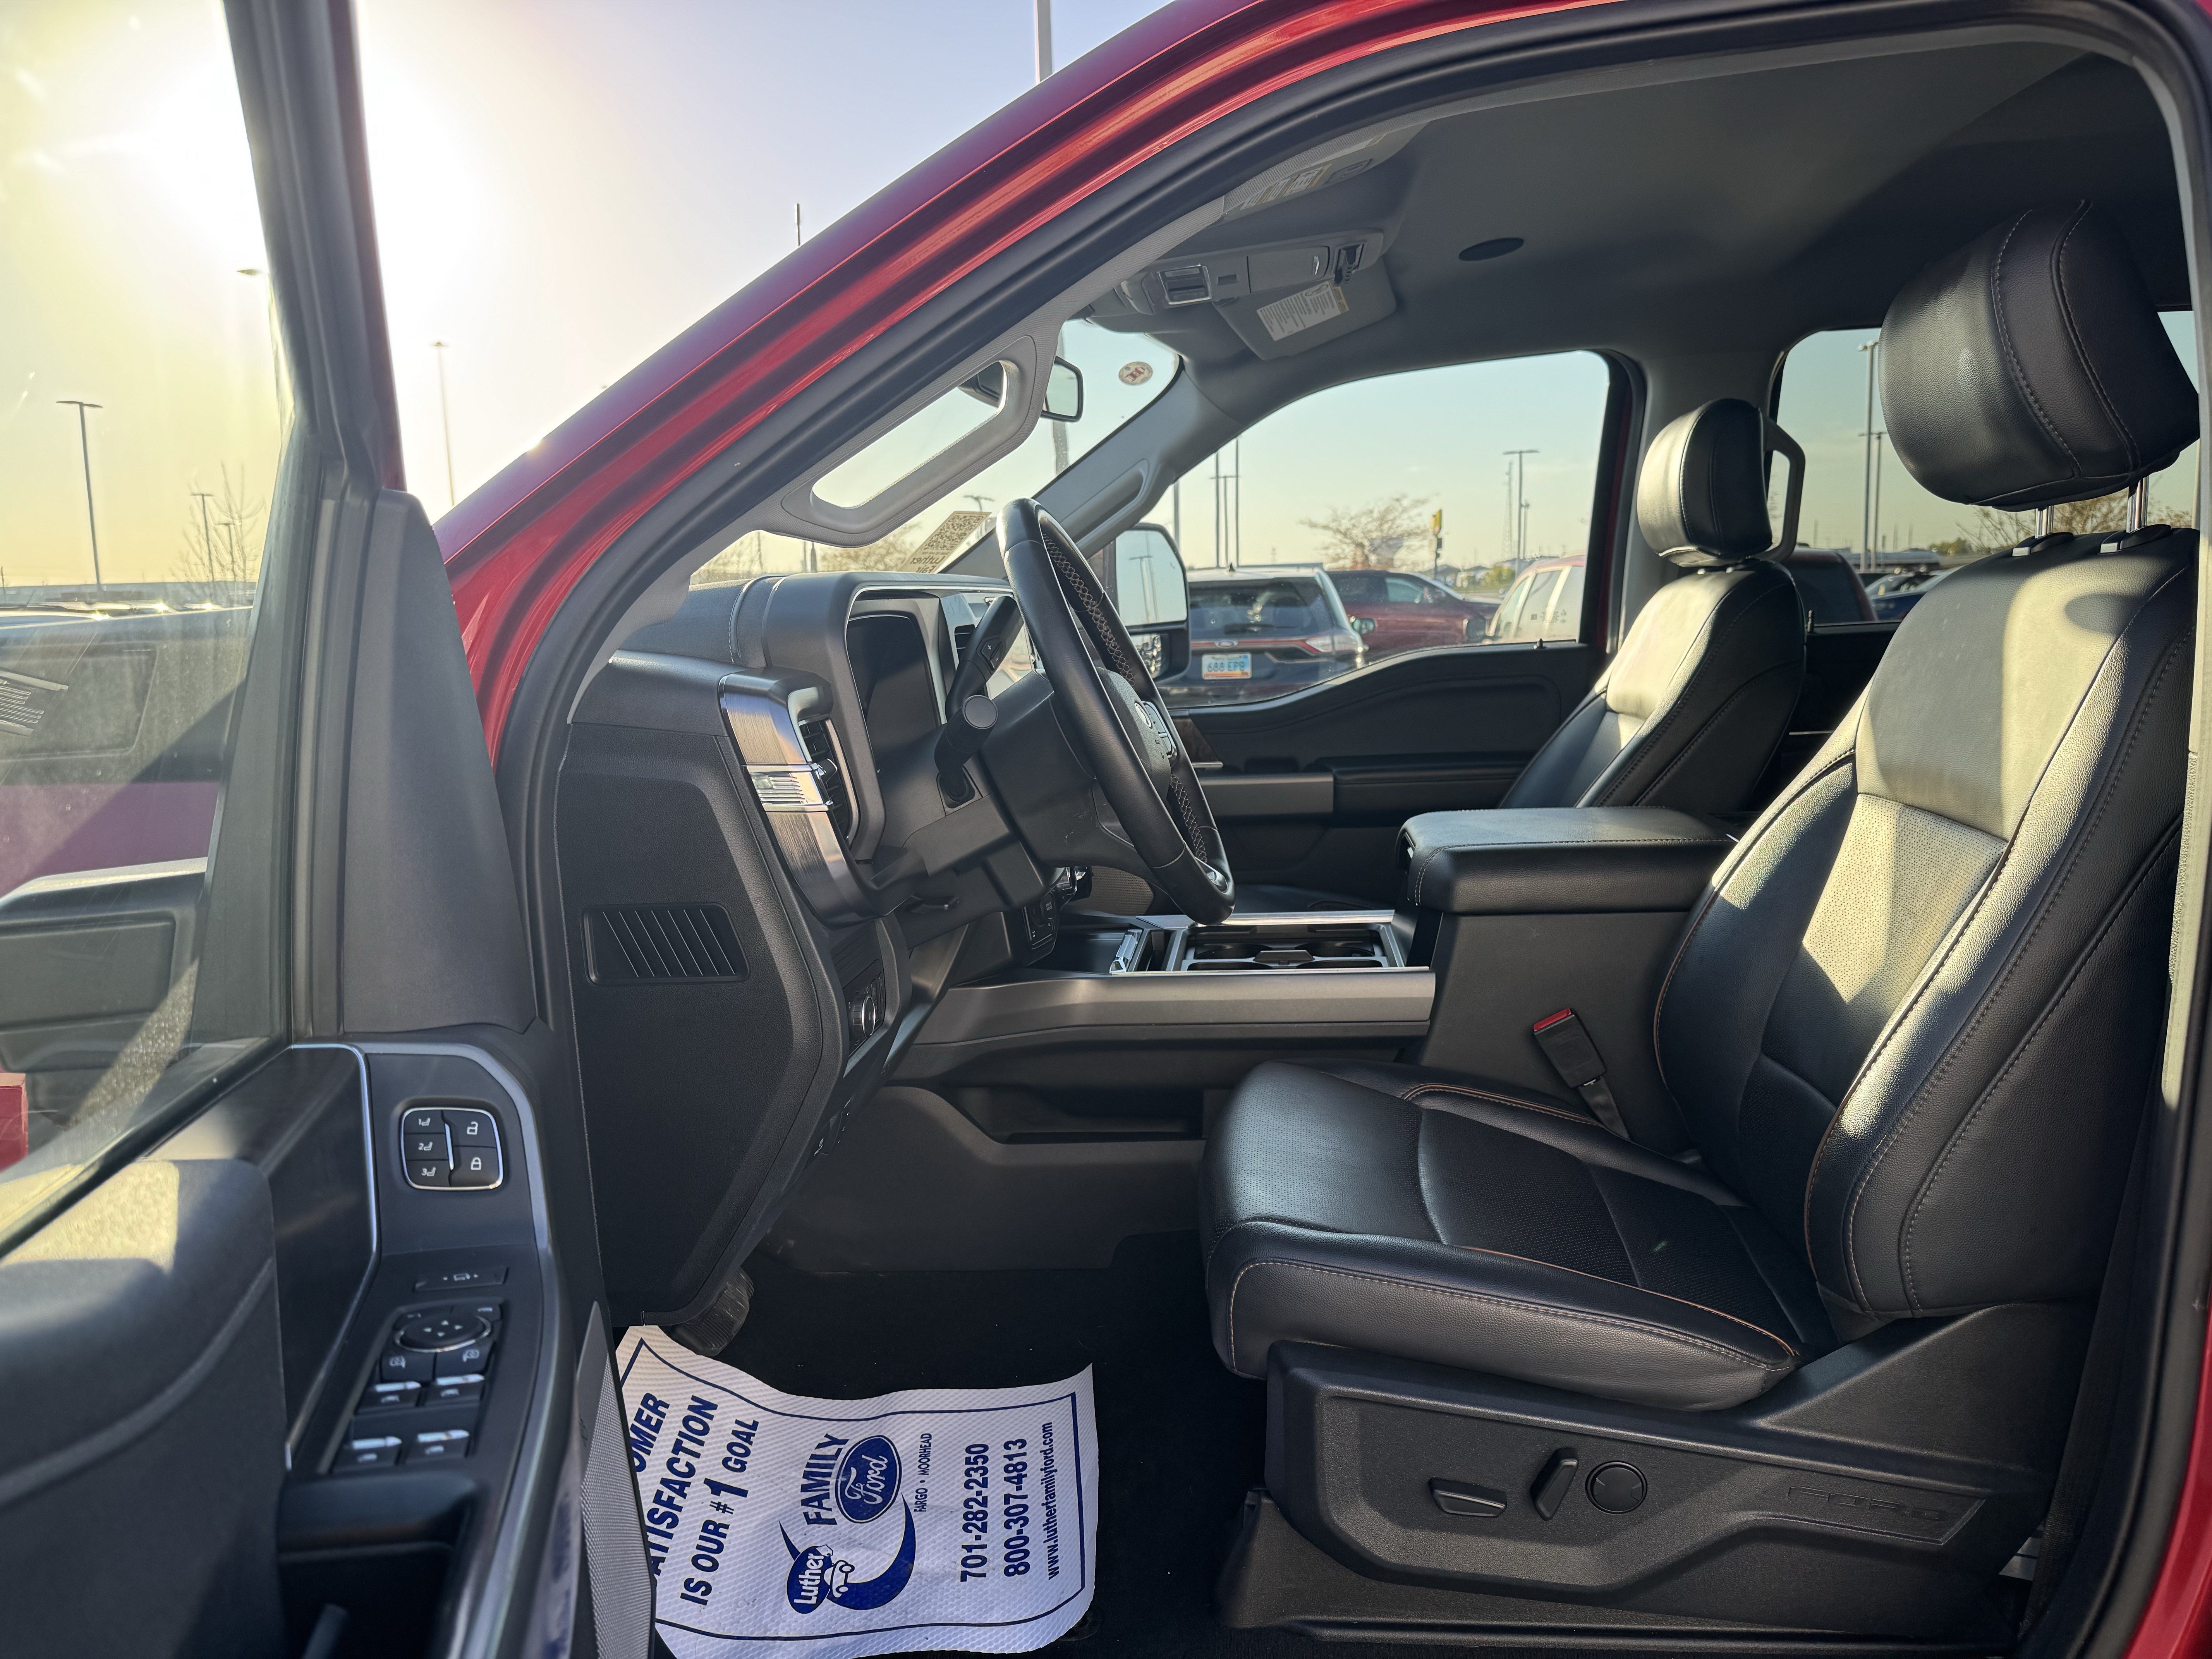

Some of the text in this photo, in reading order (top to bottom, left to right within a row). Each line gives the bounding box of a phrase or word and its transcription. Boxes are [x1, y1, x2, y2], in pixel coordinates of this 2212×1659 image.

[721, 1419, 759, 1473] GOAL
[800, 1433, 850, 1525] FAMILY
[845, 1455, 888, 1504] Ford
[914, 1433, 932, 1512] FARGO MOORHEAD
[646, 1395, 718, 1577] ATISFACTION
[960, 1443, 989, 1582] 701-282-2350
[1003, 1438, 1030, 1577] 800-307-4813
[1040, 1422, 1060, 1580] www.lutherfamilyford.com
[691, 1519, 730, 1573] OUR
[793, 1553, 824, 1604] Luther
[680, 1578, 712, 1606] IS
